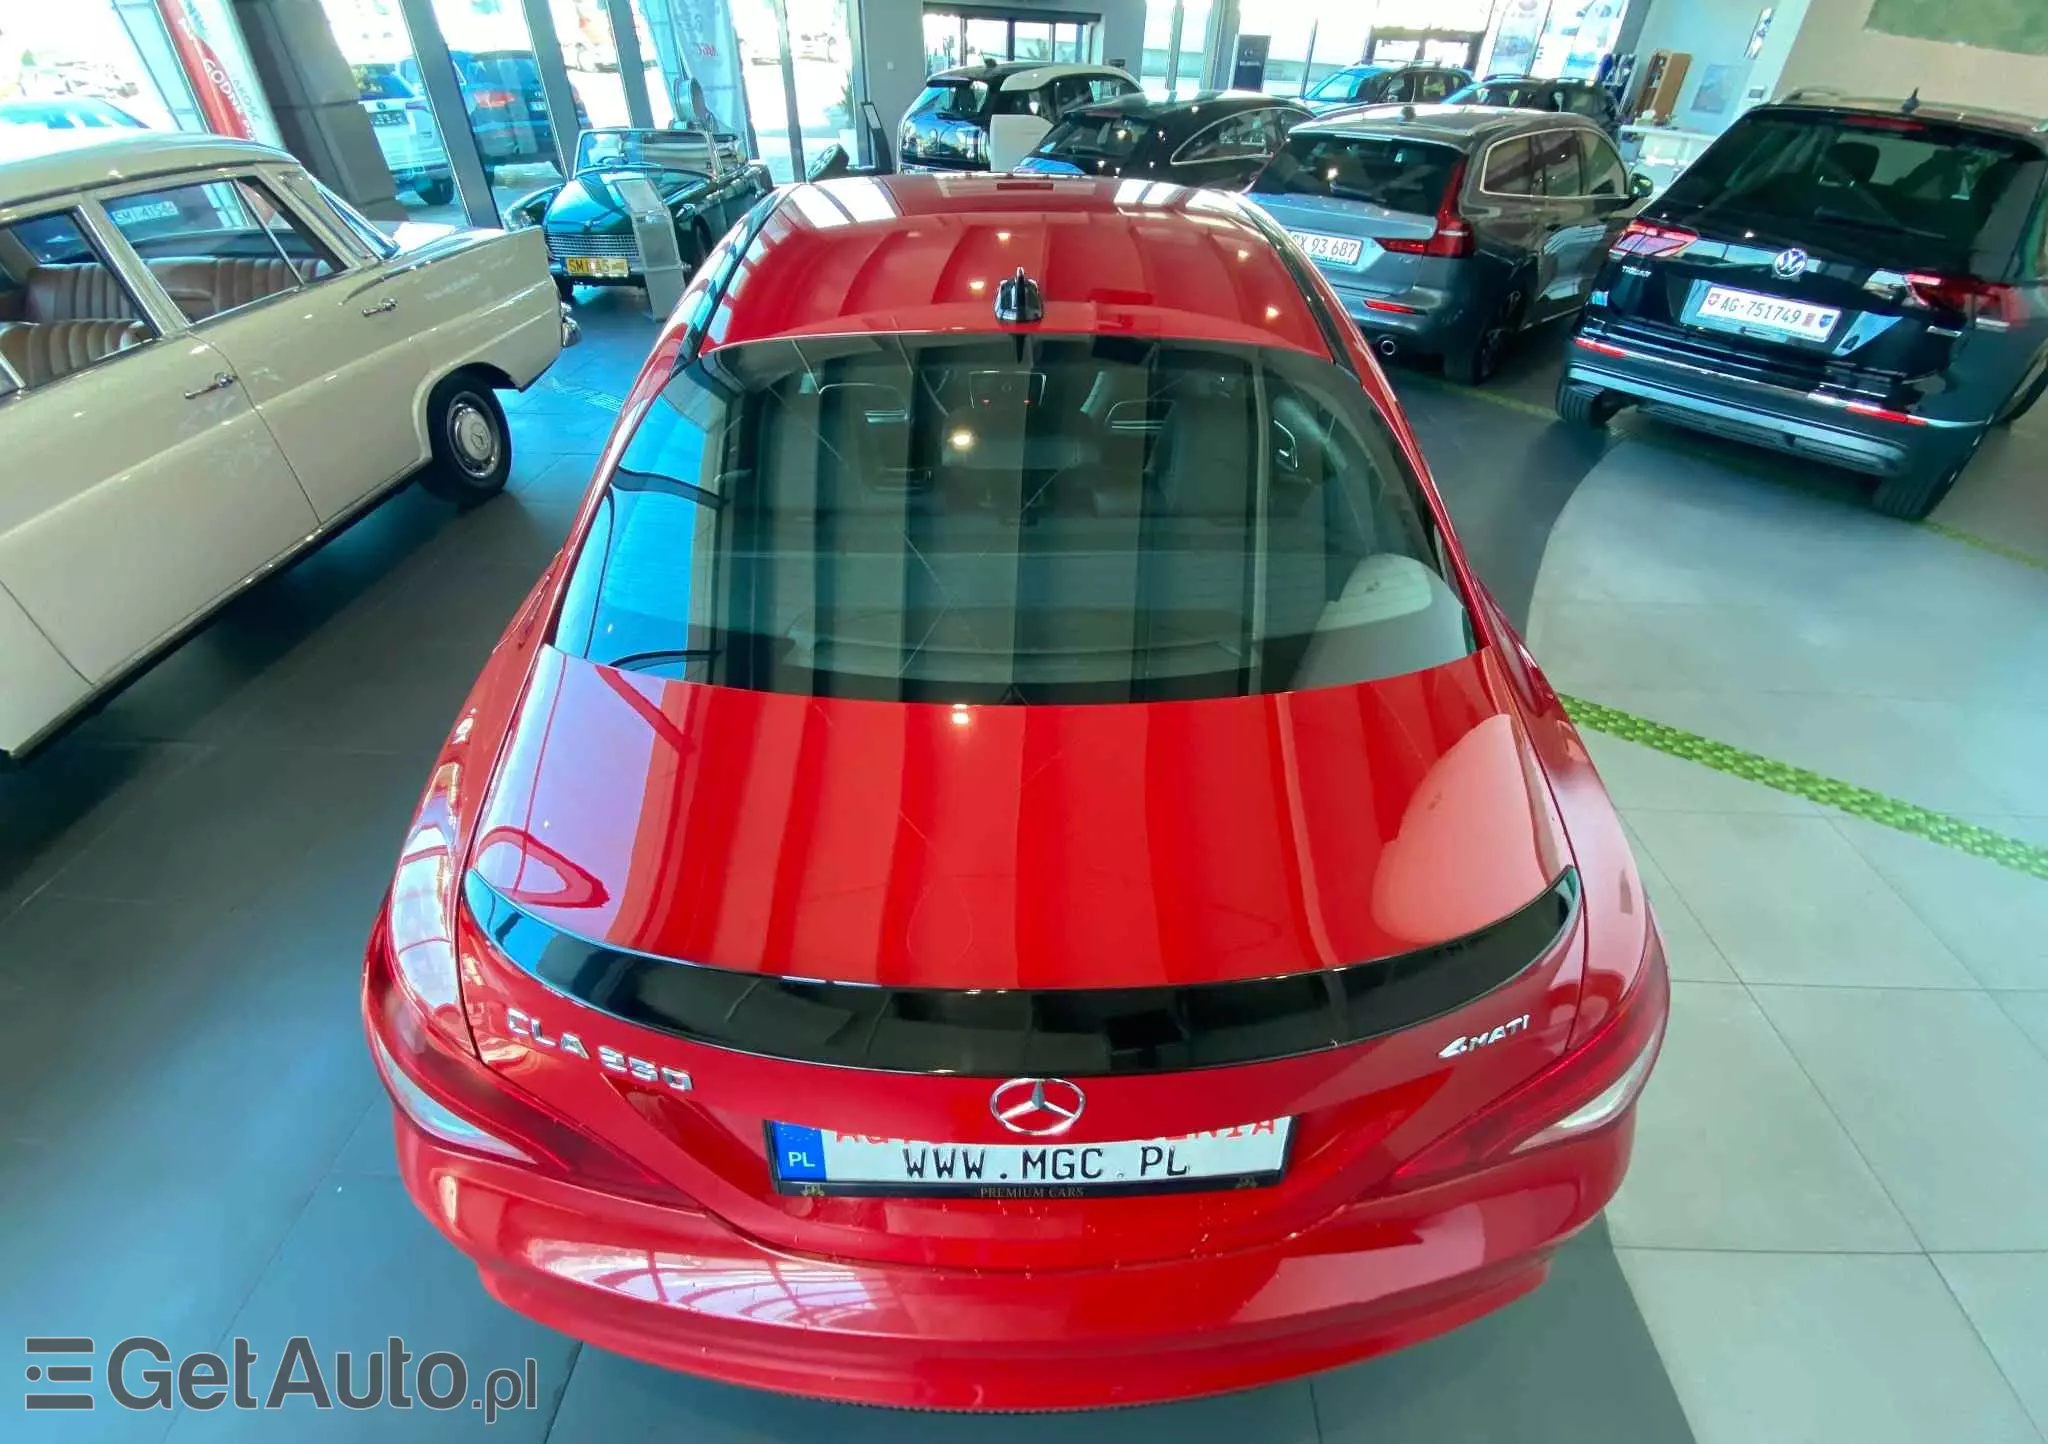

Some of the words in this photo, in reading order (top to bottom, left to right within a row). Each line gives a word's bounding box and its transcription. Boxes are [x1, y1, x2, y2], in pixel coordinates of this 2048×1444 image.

[1330, 241, 1358, 259] 687
[507, 1007, 591, 1060] CLA
[787, 1151, 816, 1168] PL
[980, 1187, 1044, 1198] PREMIUM
[1048, 1187, 1084, 1198] CARS
